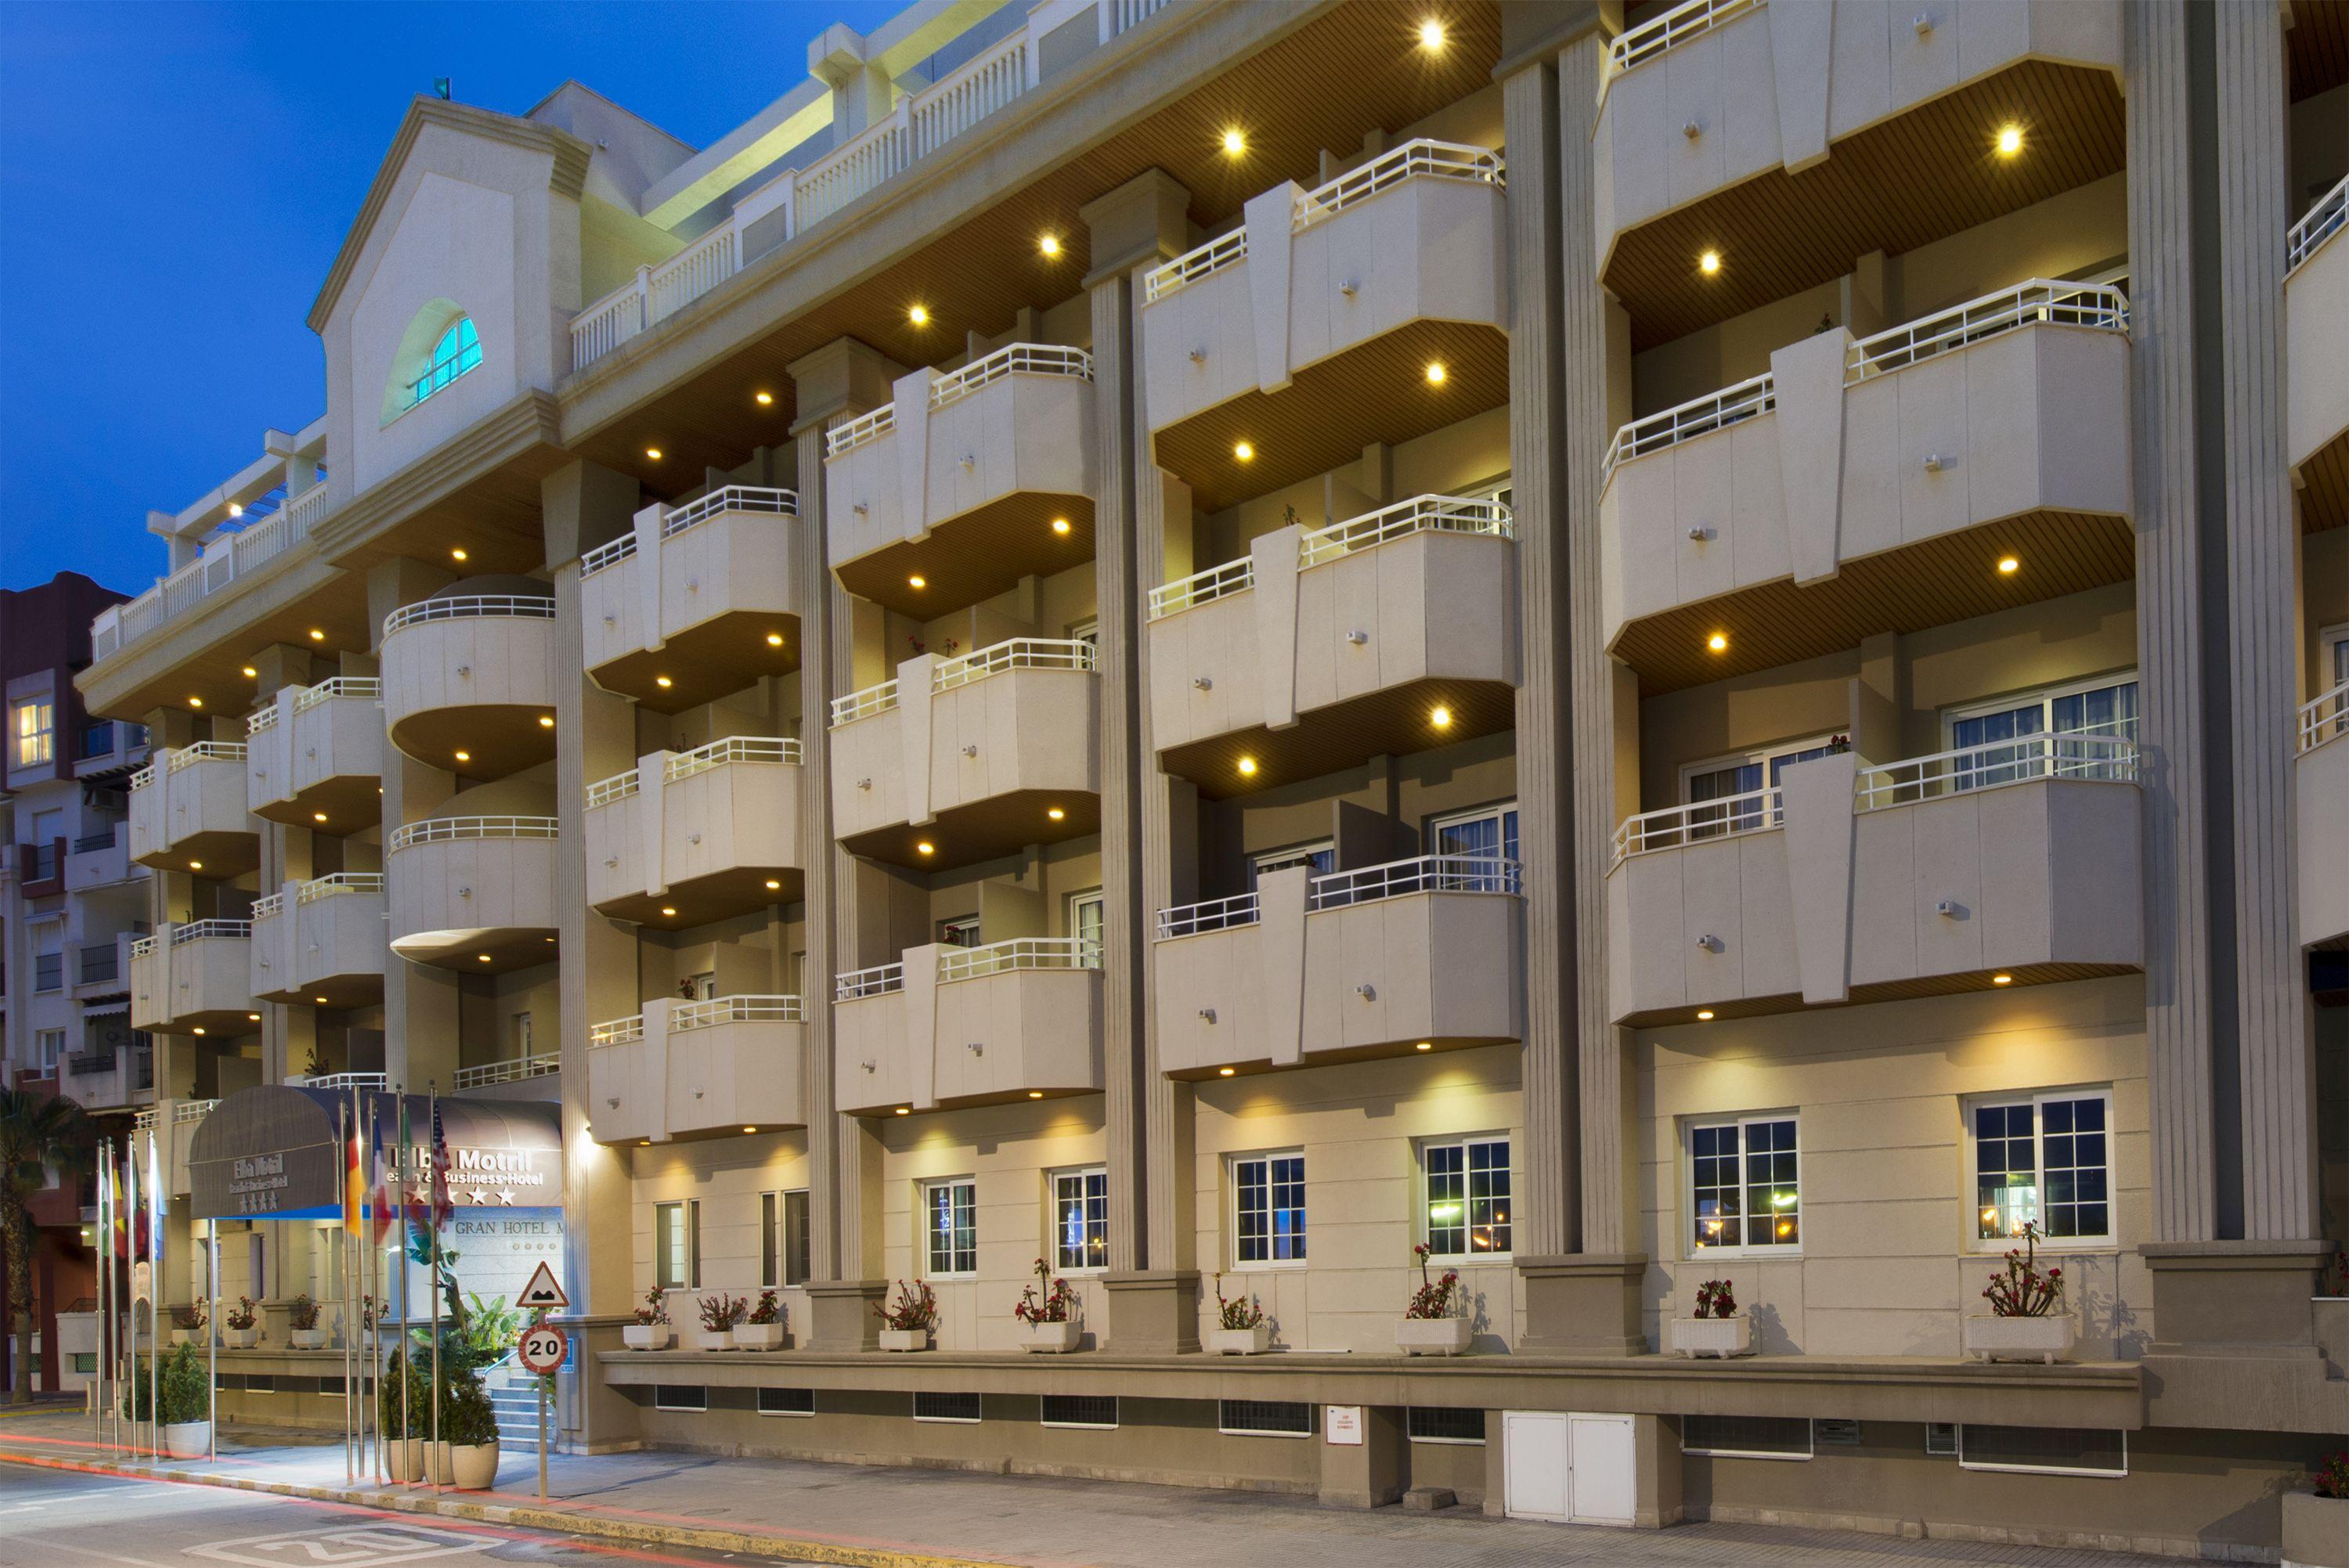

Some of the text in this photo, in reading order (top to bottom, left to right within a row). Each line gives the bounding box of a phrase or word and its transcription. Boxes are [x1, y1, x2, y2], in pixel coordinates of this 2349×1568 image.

[234, 1159, 254, 1180] Elba
[457, 1148, 532, 1171] Motril
[455, 1221, 496, 1235] GRAN
[503, 1221, 550, 1235] HOTEL
[529, 1339, 558, 1356] 20
[254, 1532, 442, 1562] 20
